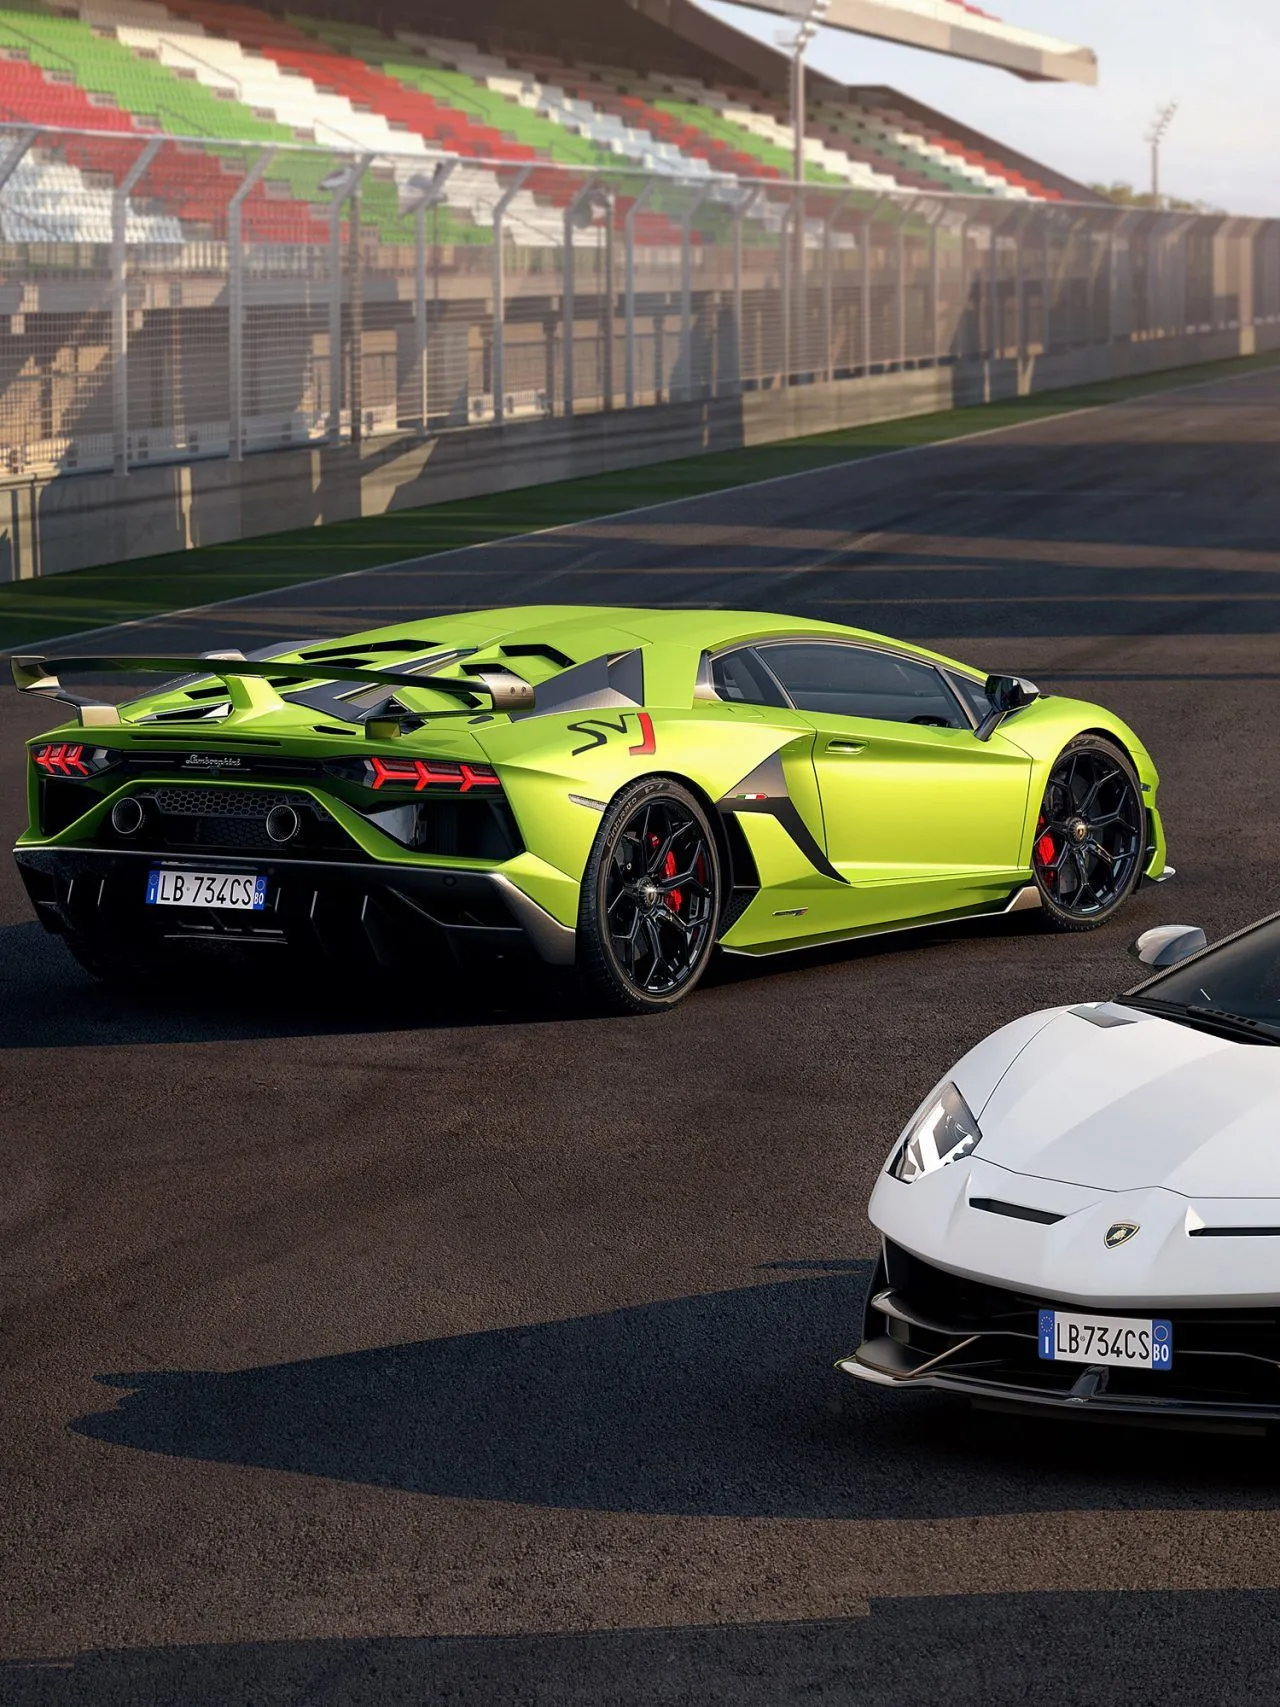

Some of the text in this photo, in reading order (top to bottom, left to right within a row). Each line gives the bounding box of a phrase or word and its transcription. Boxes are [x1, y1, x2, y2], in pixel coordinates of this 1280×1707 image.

[644, 783, 664, 794] P7
[254, 892, 264, 905] BO
[1153, 1344, 1169, 1362] BO
